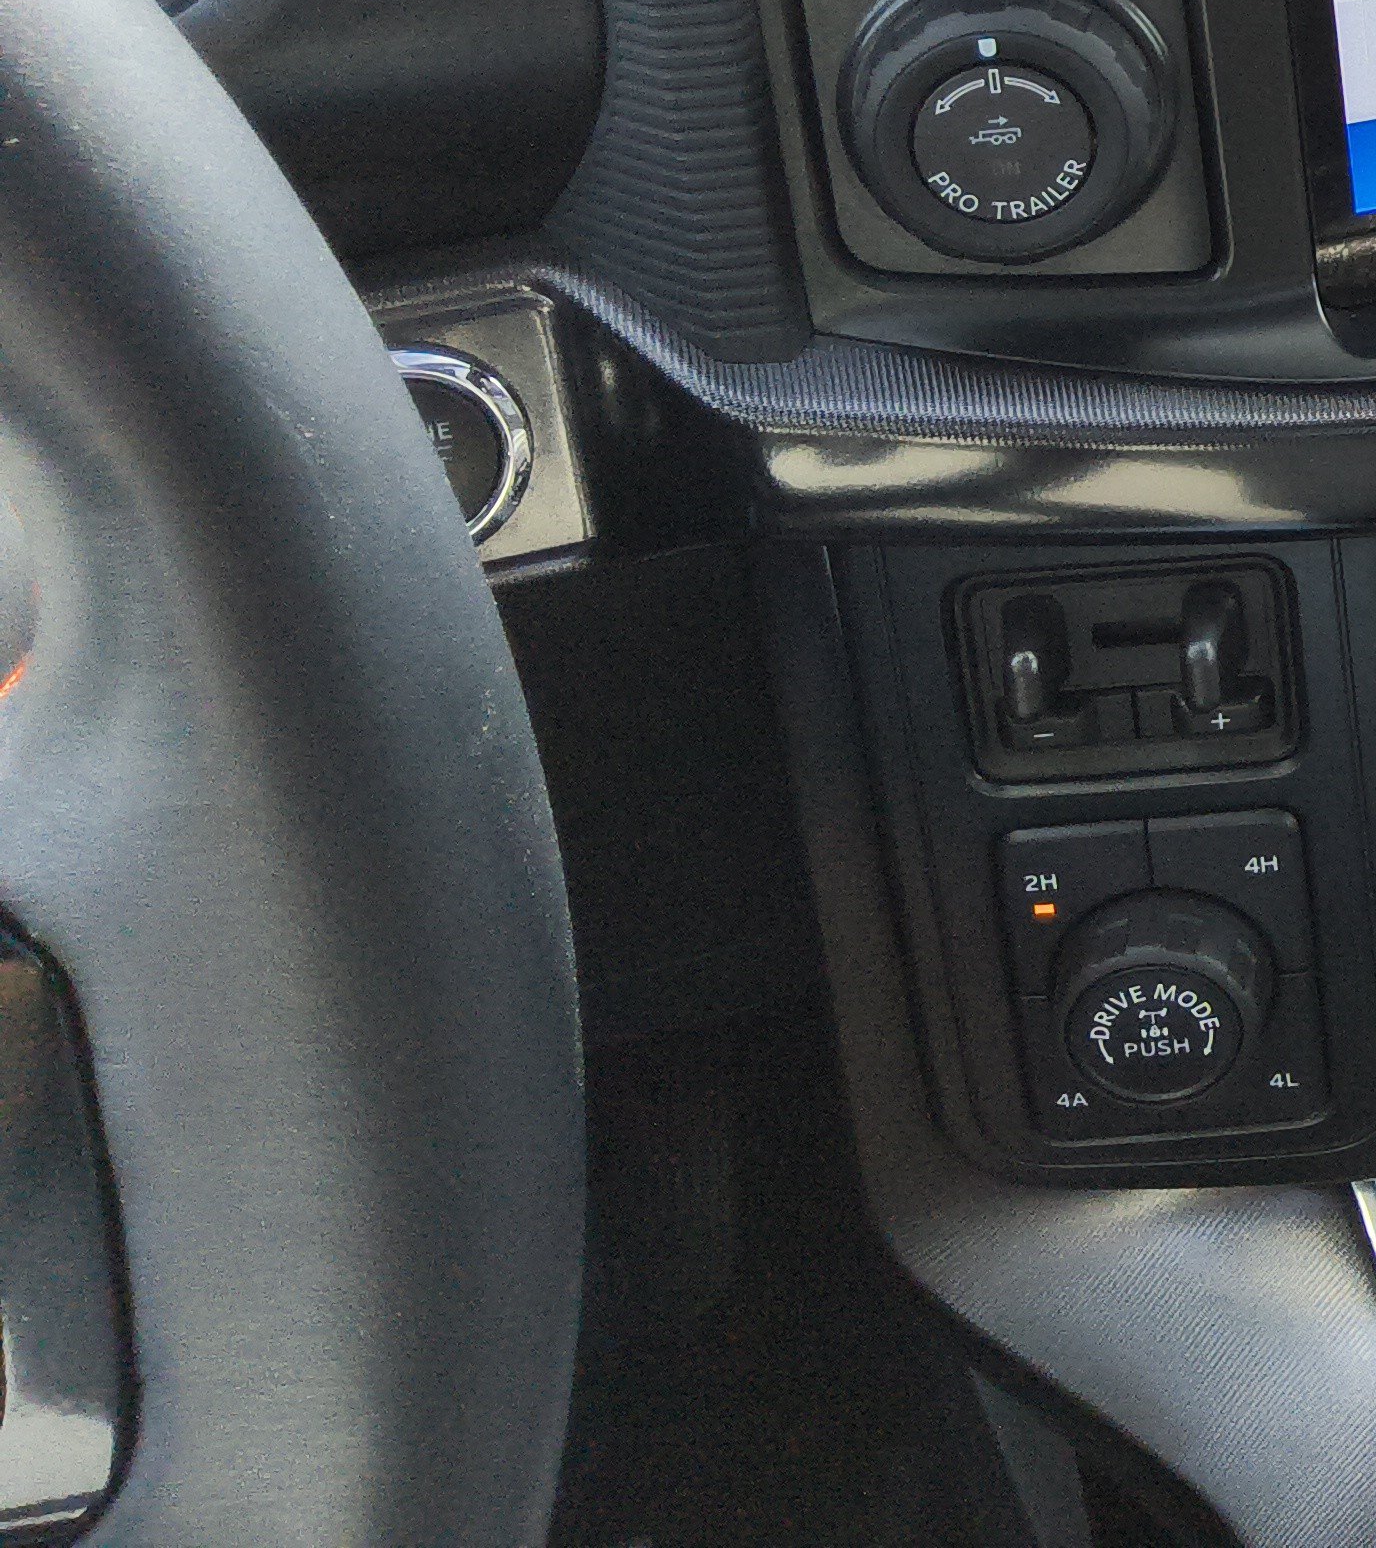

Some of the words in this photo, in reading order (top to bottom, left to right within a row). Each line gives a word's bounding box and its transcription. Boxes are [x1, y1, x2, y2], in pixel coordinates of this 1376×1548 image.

[928, 170, 979, 215] PRO
[991, 158, 1088, 221] TRAILER
[1243, 855, 1279, 874] 4H
[1024, 874, 1058, 892] 2H
[1090, 984, 1148, 1042] DRIVE
[1152, 983, 1221, 1033] MODE
[1123, 1037, 1191, 1059] PUSH
[1269, 1073, 1300, 1088] 4L
[1056, 1092, 1089, 1108] 4A
